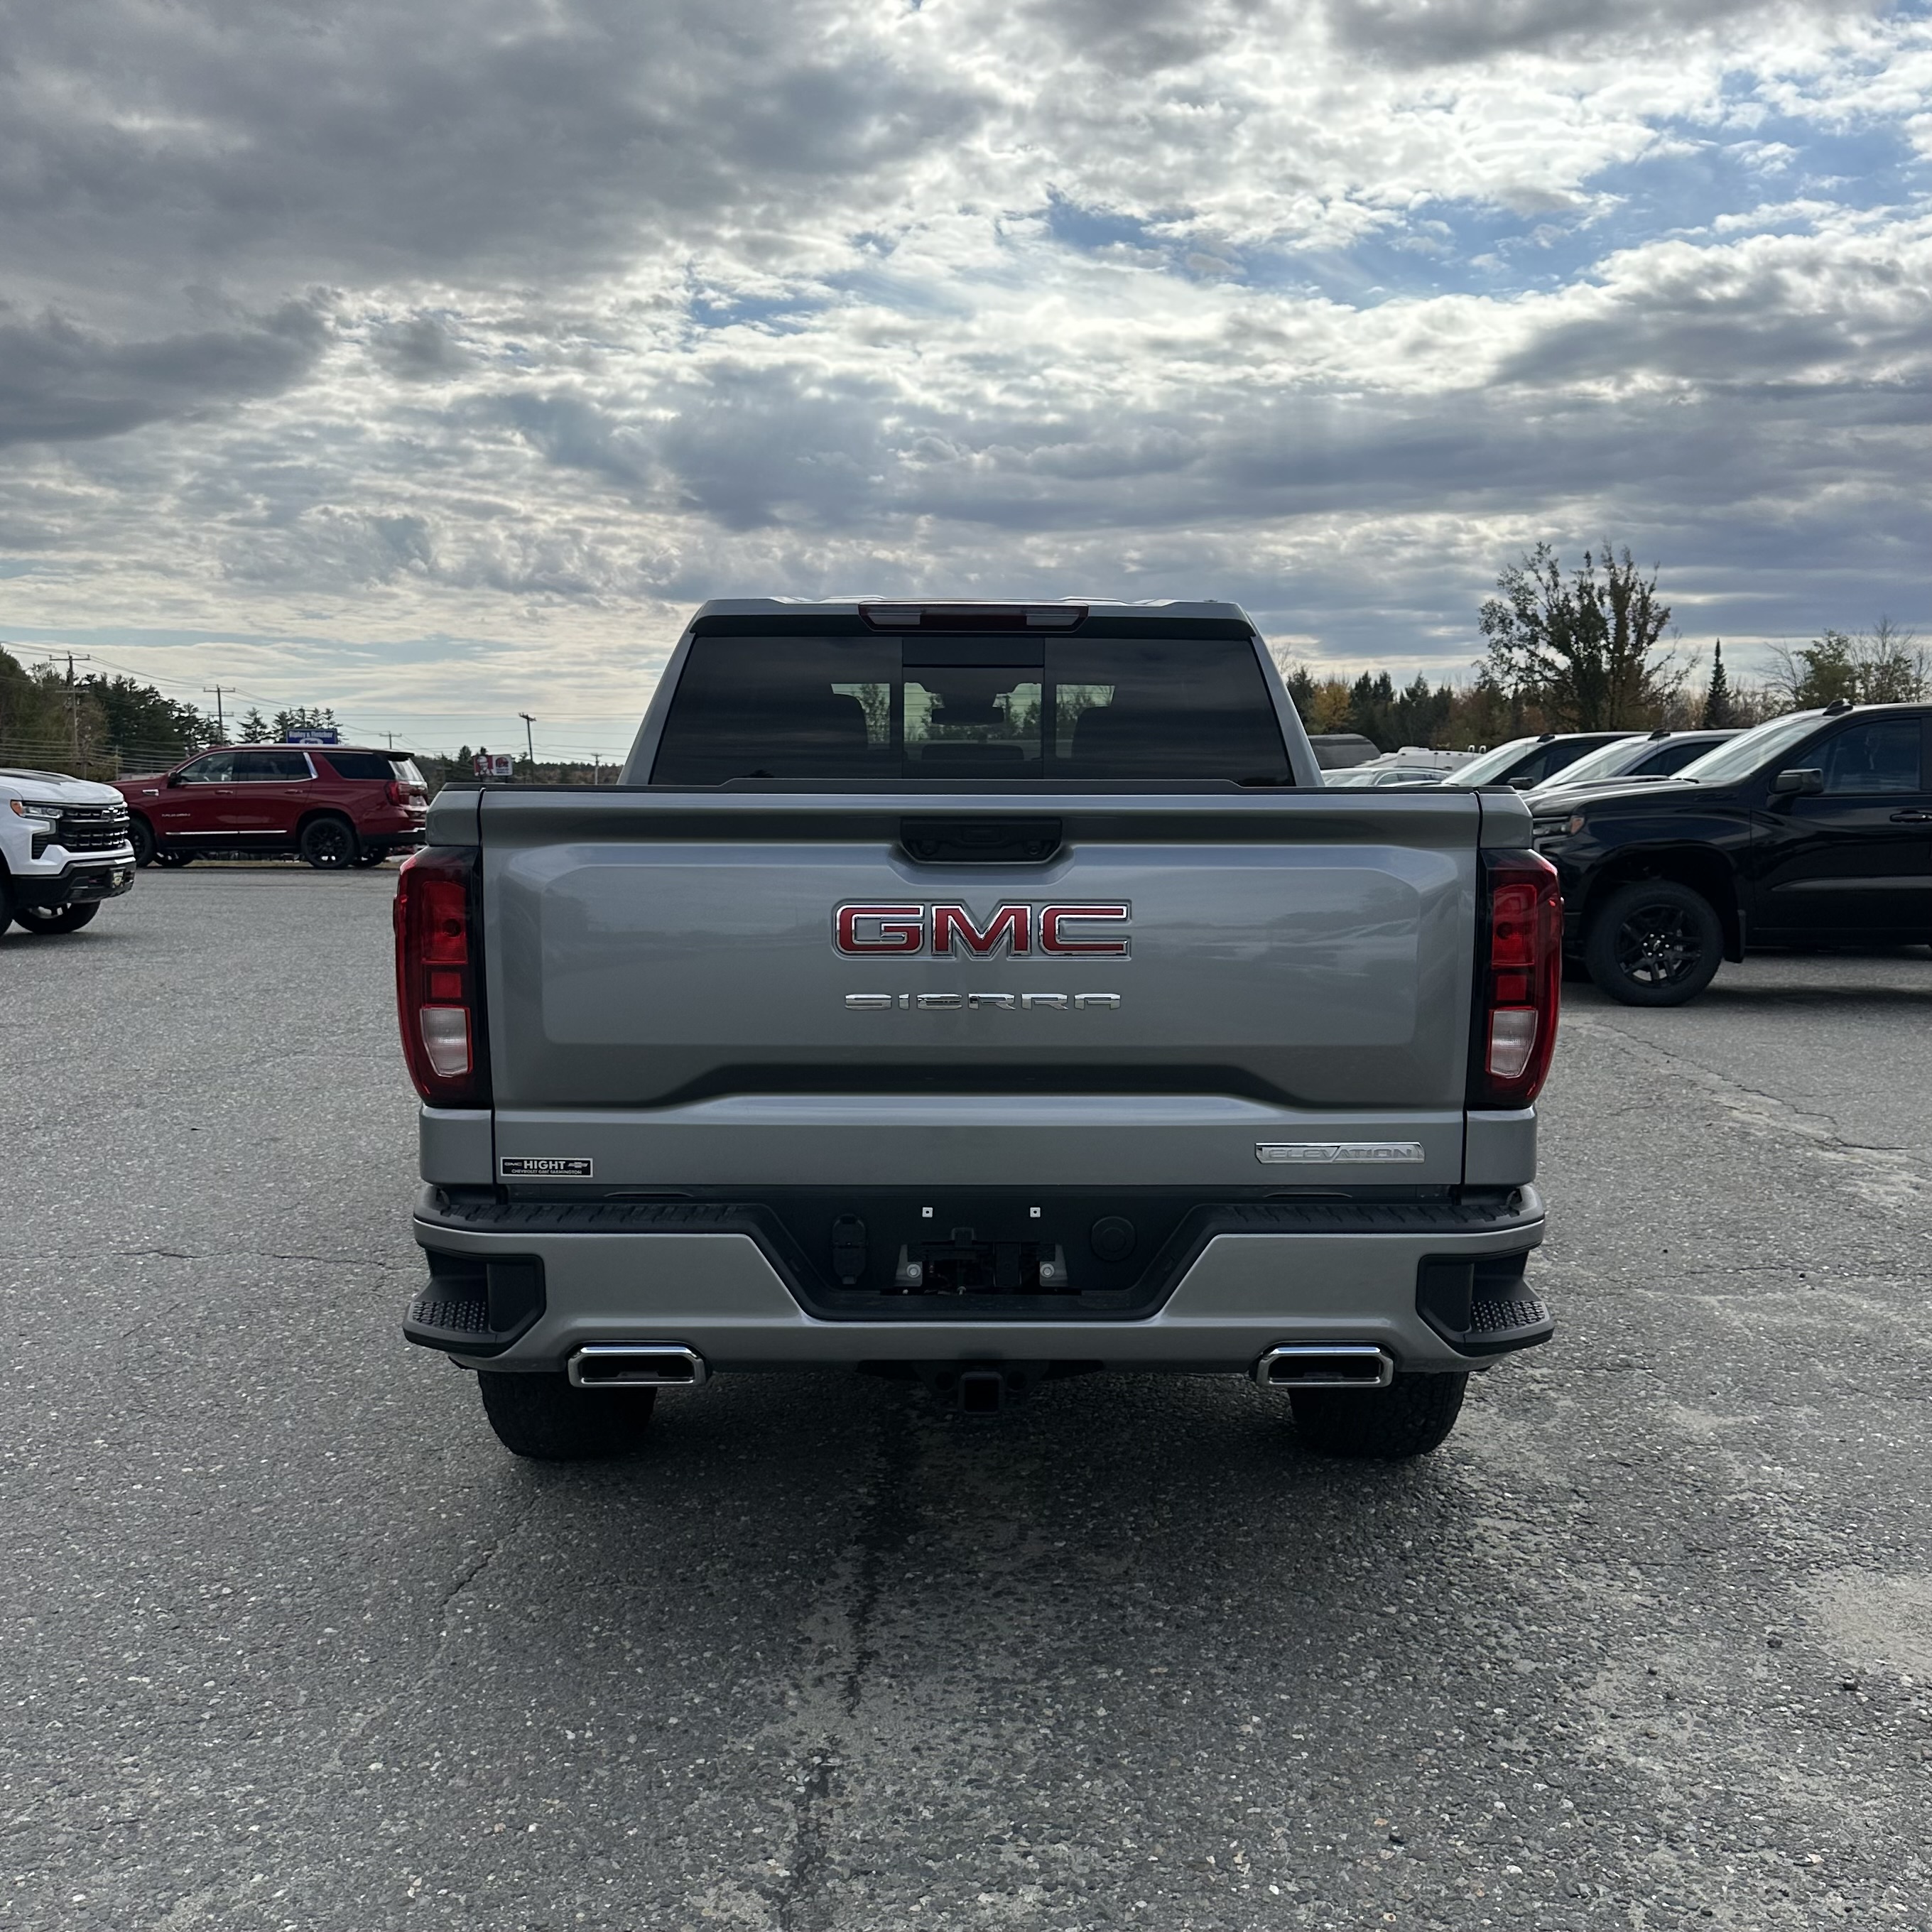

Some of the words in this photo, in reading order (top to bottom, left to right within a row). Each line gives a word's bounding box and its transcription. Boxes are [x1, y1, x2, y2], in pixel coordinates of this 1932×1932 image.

[835, 903, 1129, 956] GMC
[845, 994, 1121, 1010] SIERRA
[1269, 1148, 1412, 1159] ELEVATION
[523, 1160, 566, 1170] HIGHT
